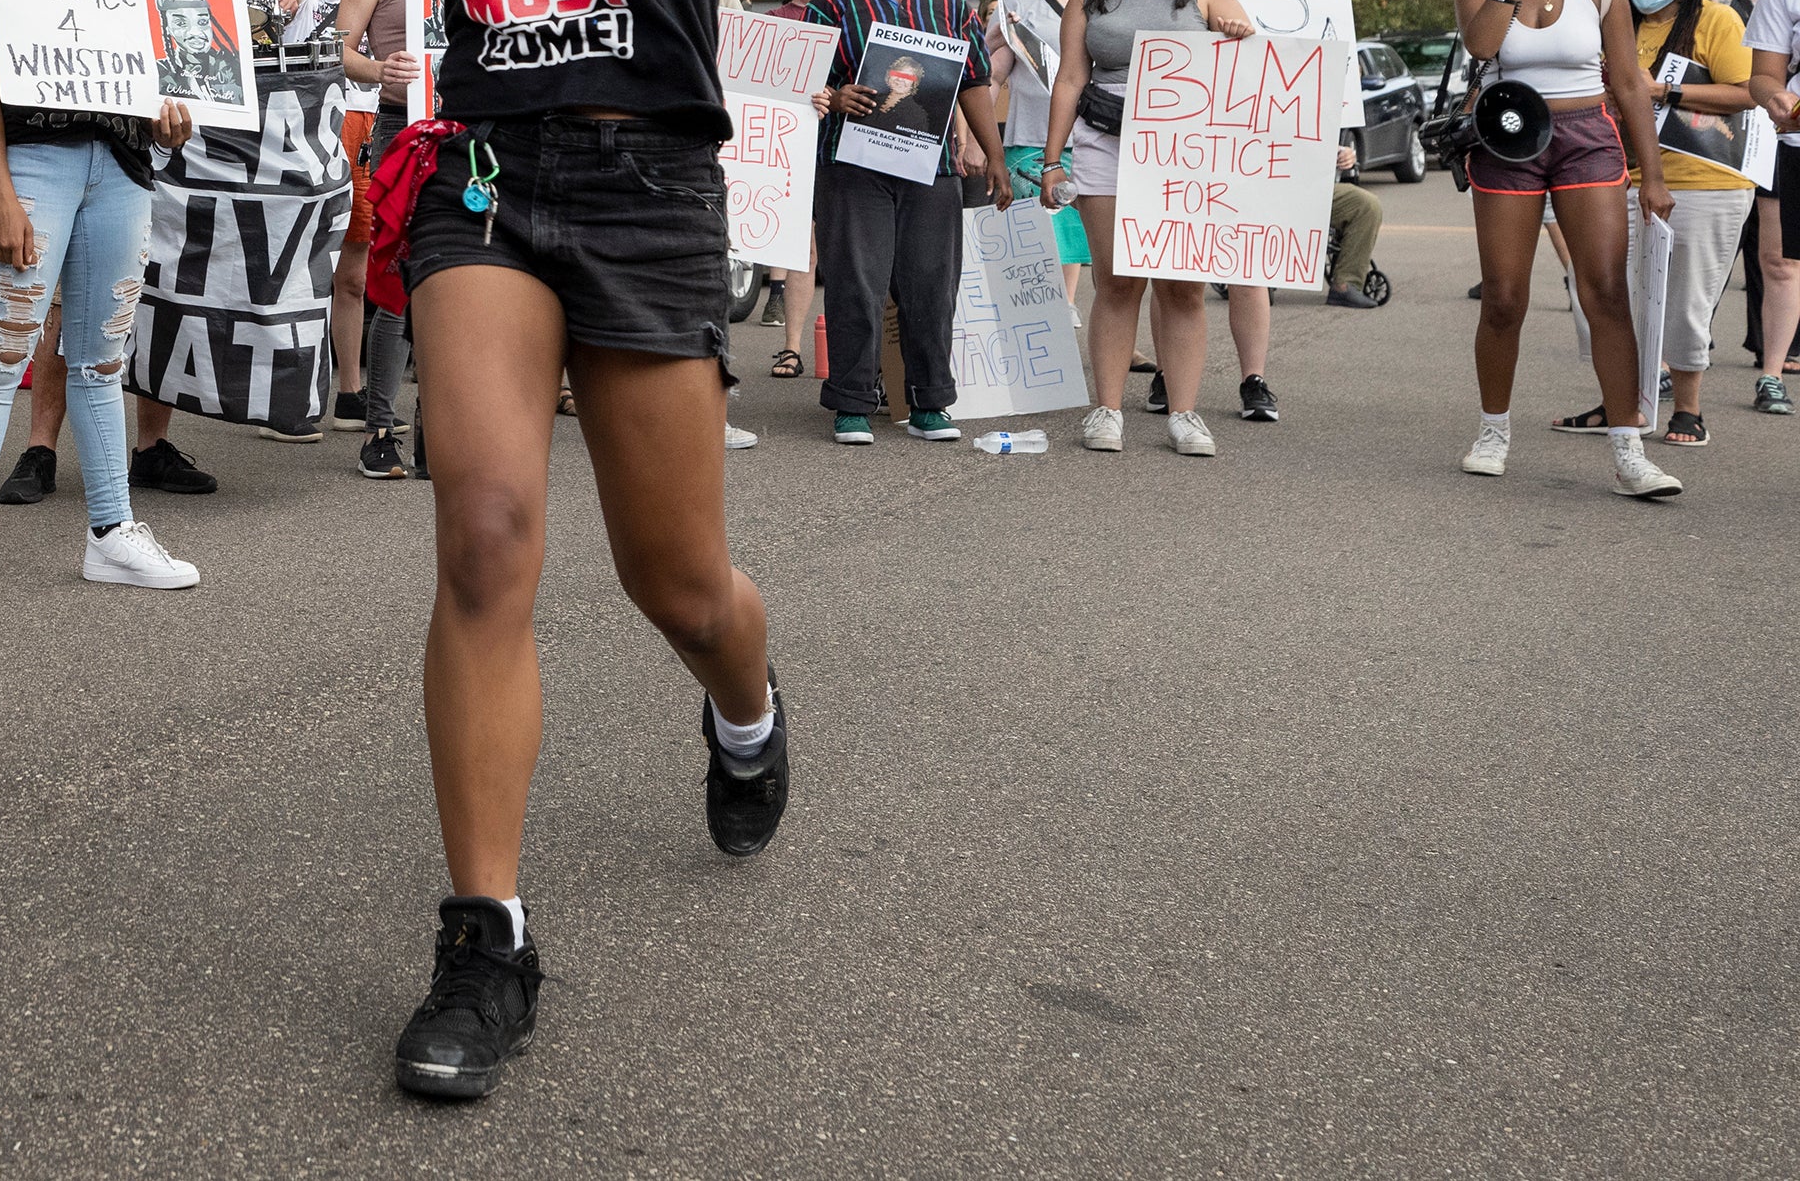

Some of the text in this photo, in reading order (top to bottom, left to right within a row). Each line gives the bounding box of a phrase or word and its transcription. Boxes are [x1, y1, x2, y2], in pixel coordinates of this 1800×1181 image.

[57, 8, 87, 42] 4
[477, 9, 634, 72] COME!
[875, 28, 964, 56] RESIGN NOW!
[6, 43, 146, 77] WINSTON
[36, 79, 132, 106] SMITH
[1132, 37, 1322, 141] BLM
[853, 126, 929, 150] FAILURE BACK THEN AND
[868, 138, 910, 153] FAILURE NOW
[1132, 130, 1293, 179] JUSTICE
[1162, 179, 1239, 216] FOR
[1122, 218, 1322, 284] WINSTON
[1002, 258, 1054, 281] JUSTICE
[1020, 275, 1052, 289] FOR
[1010, 285, 1064, 308] WINSTON
